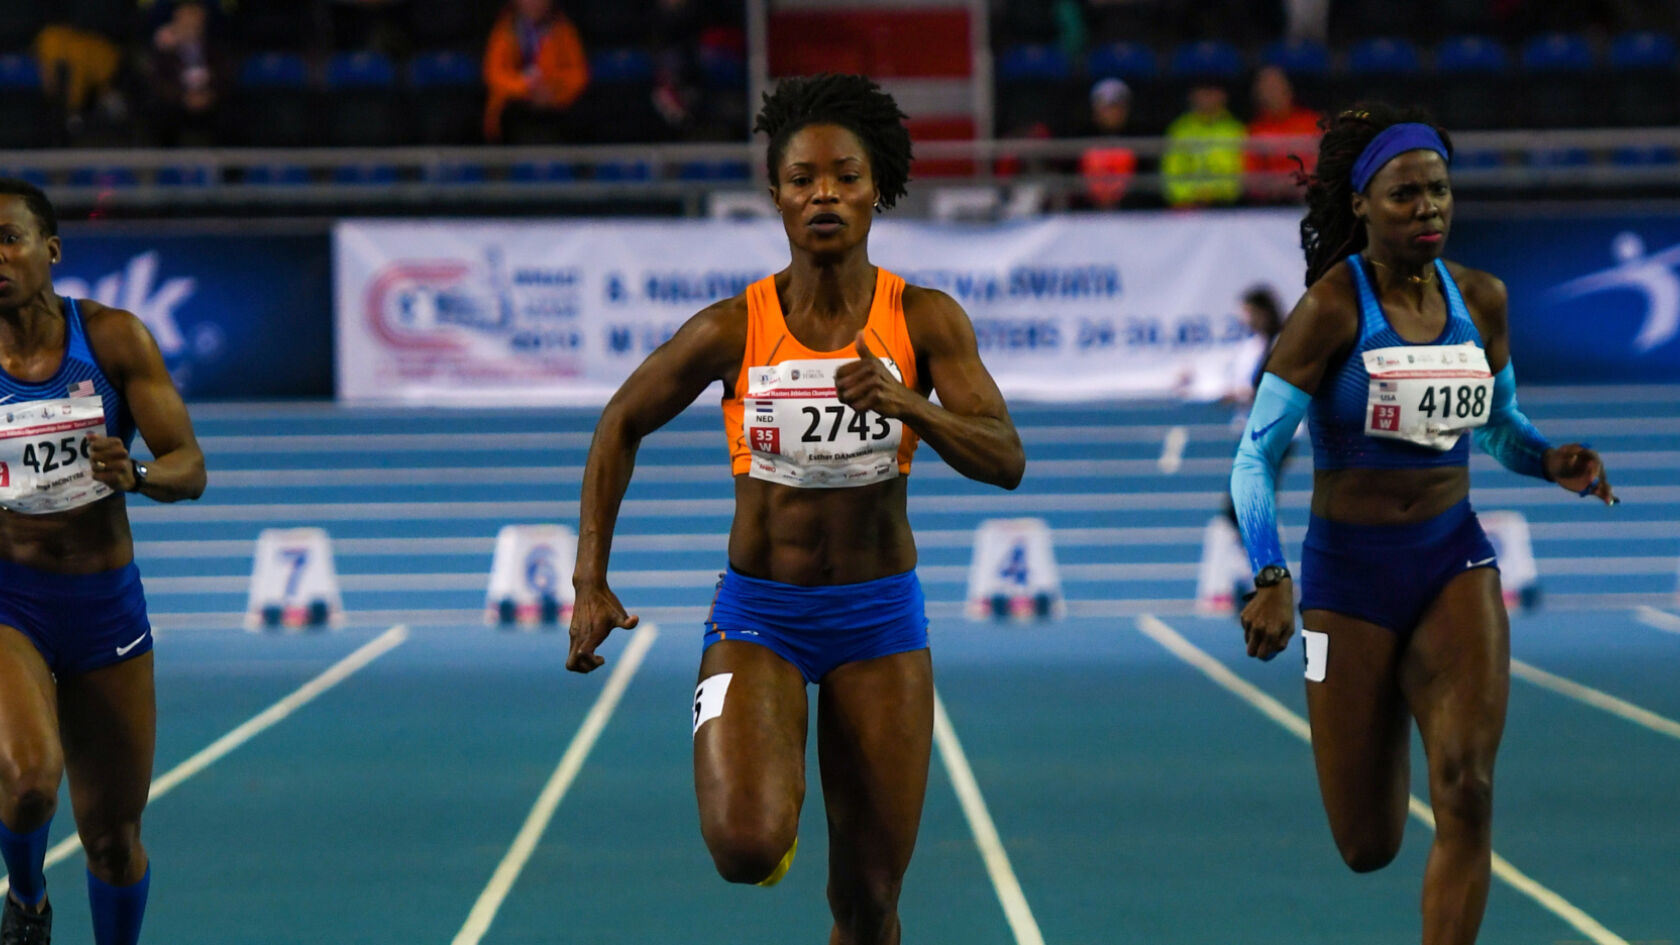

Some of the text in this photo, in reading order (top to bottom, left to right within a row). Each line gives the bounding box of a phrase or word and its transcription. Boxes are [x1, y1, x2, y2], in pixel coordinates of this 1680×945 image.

[812, 389, 837, 397] Champion
[1418, 384, 1487, 419] 4188
[1378, 407, 1395, 418] 35
[755, 415, 774, 423] NED
[802, 406, 891, 443] 2743
[1379, 418, 1392, 429] W
[756, 429, 773, 441] 35
[758, 441, 773, 453] W
[808, 453, 833, 462] Esther
[1000, 538, 1030, 586] 4
[279, 546, 308, 597] 7
[525, 545, 560, 596] 6
